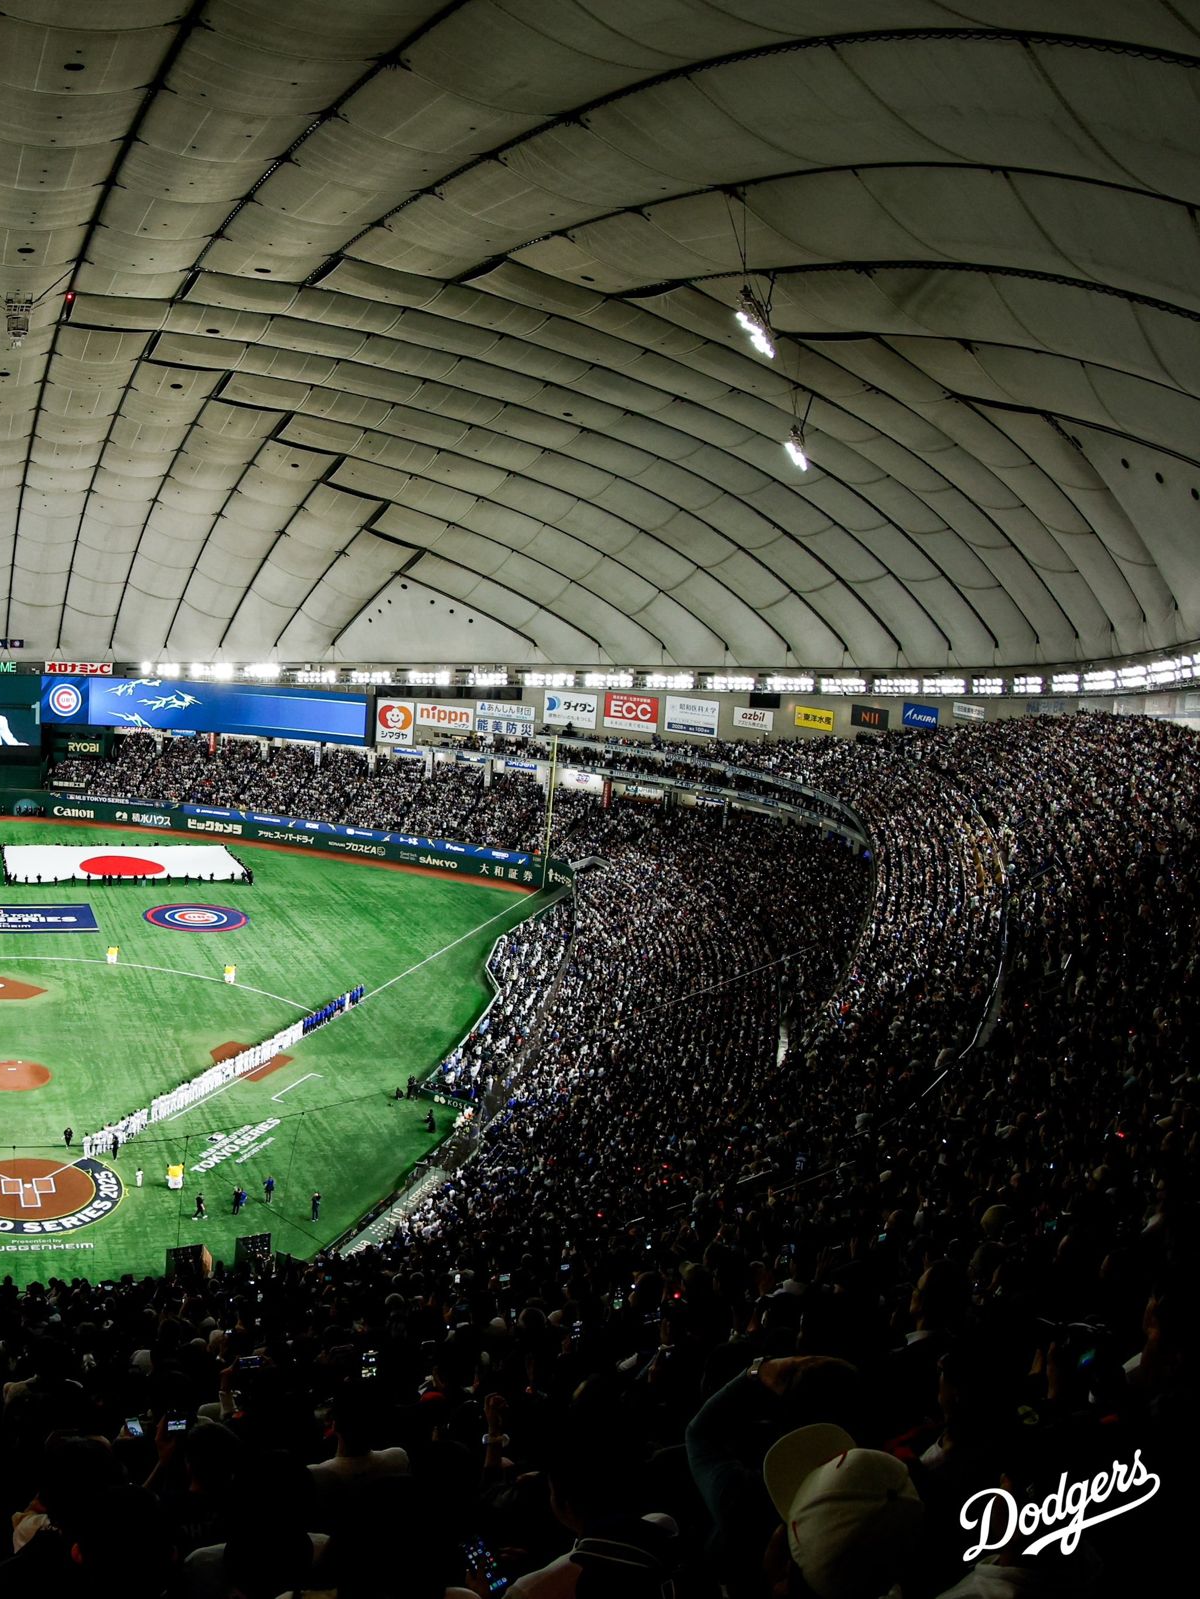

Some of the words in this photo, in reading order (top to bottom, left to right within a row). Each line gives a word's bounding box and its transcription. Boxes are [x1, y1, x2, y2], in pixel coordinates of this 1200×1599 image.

[47, 662, 111, 674] オロナミンC
[420, 705, 469, 723] nippn
[487, 703, 531, 716] あんしん財団
[563, 701, 595, 713] ダイダン
[610, 700, 651, 720] ECC
[741, 711, 765, 722] azbil
[381, 730, 408, 740] シマダヤ
[477, 720, 532, 736] 能美防災
[68, 742, 99, 752] RYOBI
[53, 806, 94, 819] Canon
[132, 813, 171, 826] 積水ハウス
[188, 818, 242, 834] ビックカメラ
[419, 854, 458, 869] SANKYO
[480, 863, 533, 882] 大和証券
[190, 1144, 240, 1172] TOKYO
[234, 1117, 281, 1146] SERIES
[23, 1200, 112, 1233] SERIES
[94, 1170, 119, 1199] 2025
